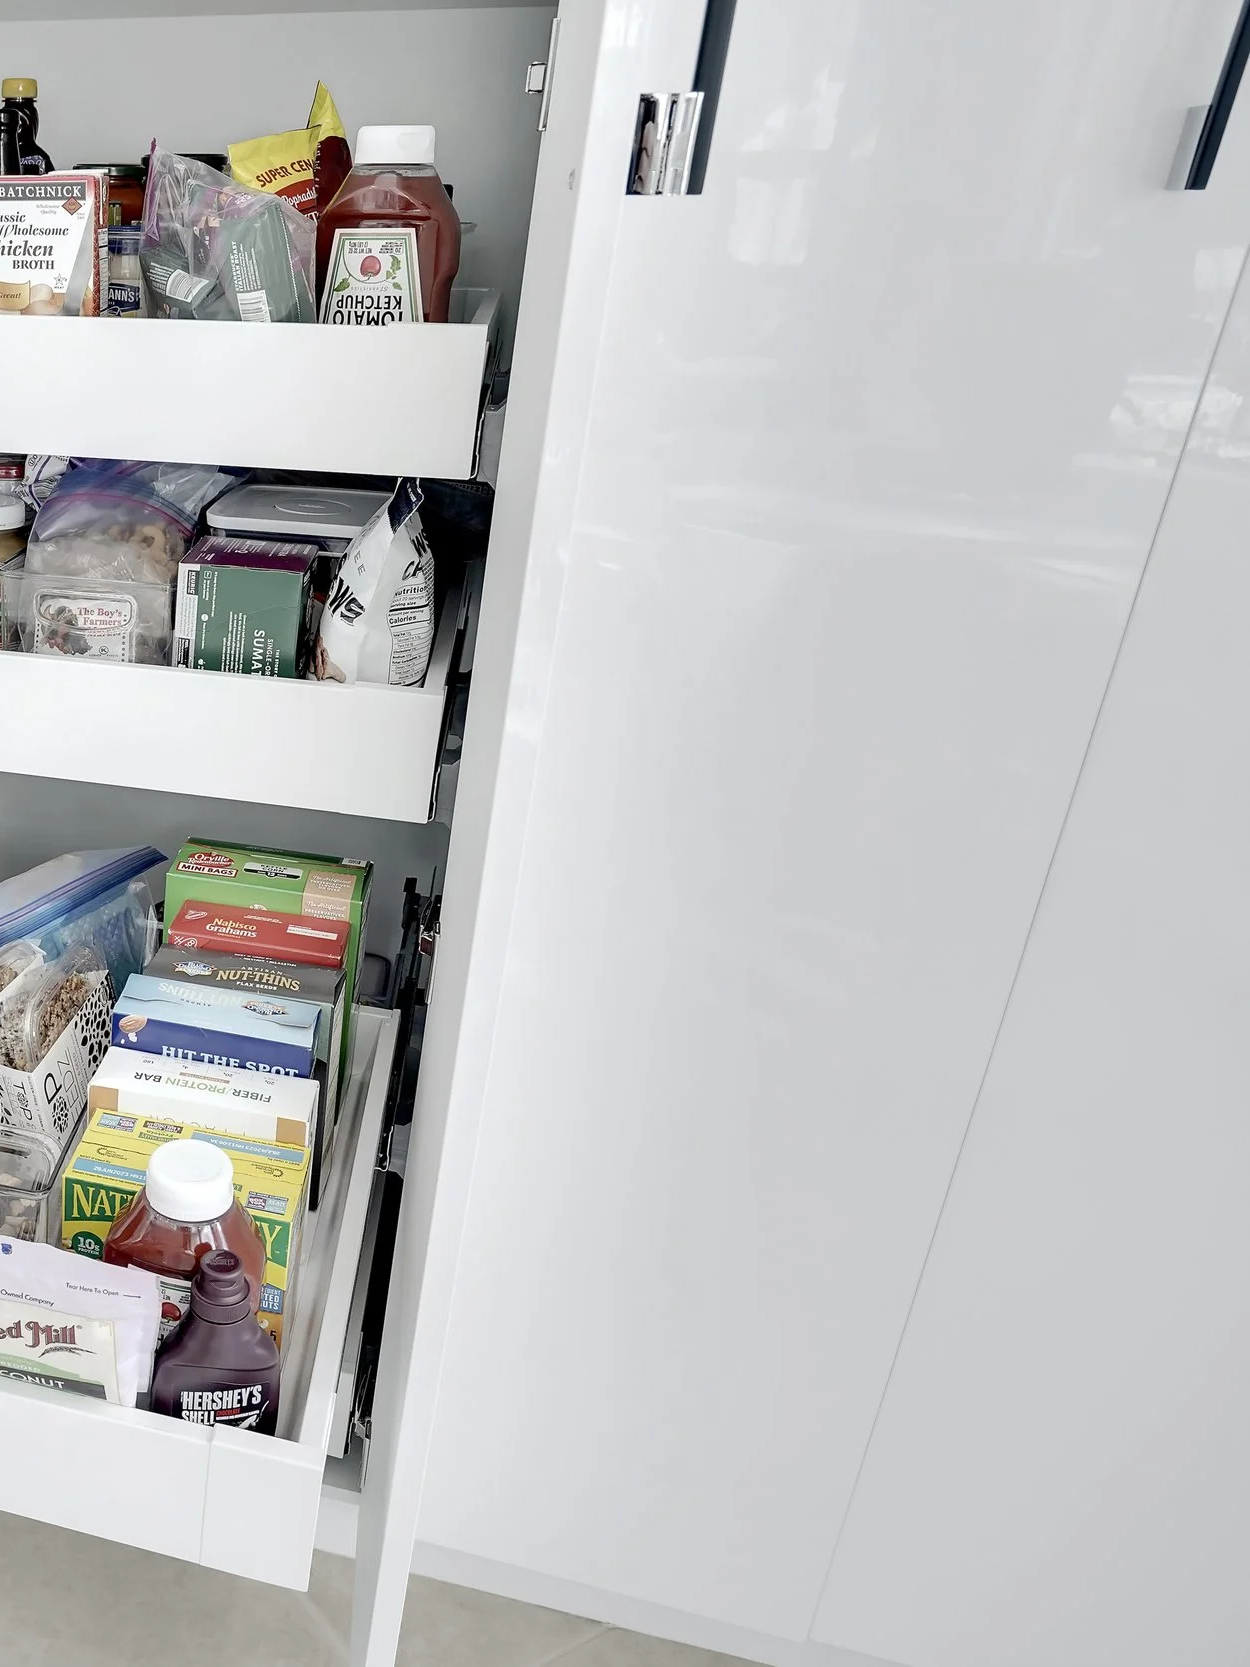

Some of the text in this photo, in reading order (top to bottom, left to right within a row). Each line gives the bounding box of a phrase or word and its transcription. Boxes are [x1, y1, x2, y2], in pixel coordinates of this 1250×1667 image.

[256, 166, 292, 187] SUPER
[13, 260, 54, 269] BROTH
[337, 295, 402, 309] KETCHUP
[332, 310, 403, 326] TOMATO
[97, 608, 122, 618] Boy's
[390, 616, 416, 624] Calories
[83, 617, 121, 626] Farmers
[195, 853, 230, 862] Orville
[206, 923, 258, 938] Grahams
[213, 918, 256, 930] Nabisco
[241, 966, 283, 975] ARTISAN
[216, 970, 300, 991] NUT-THINS
[162, 1046, 299, 1078] HIT THE SPOT
[134, 1071, 162, 1082] BAR
[24, 1293, 54, 1307] Company
[25, 1320, 78, 1348] Mill
[182, 1385, 262, 1410] HERSHEY'S
[182, 1410, 215, 1425] SHELL
